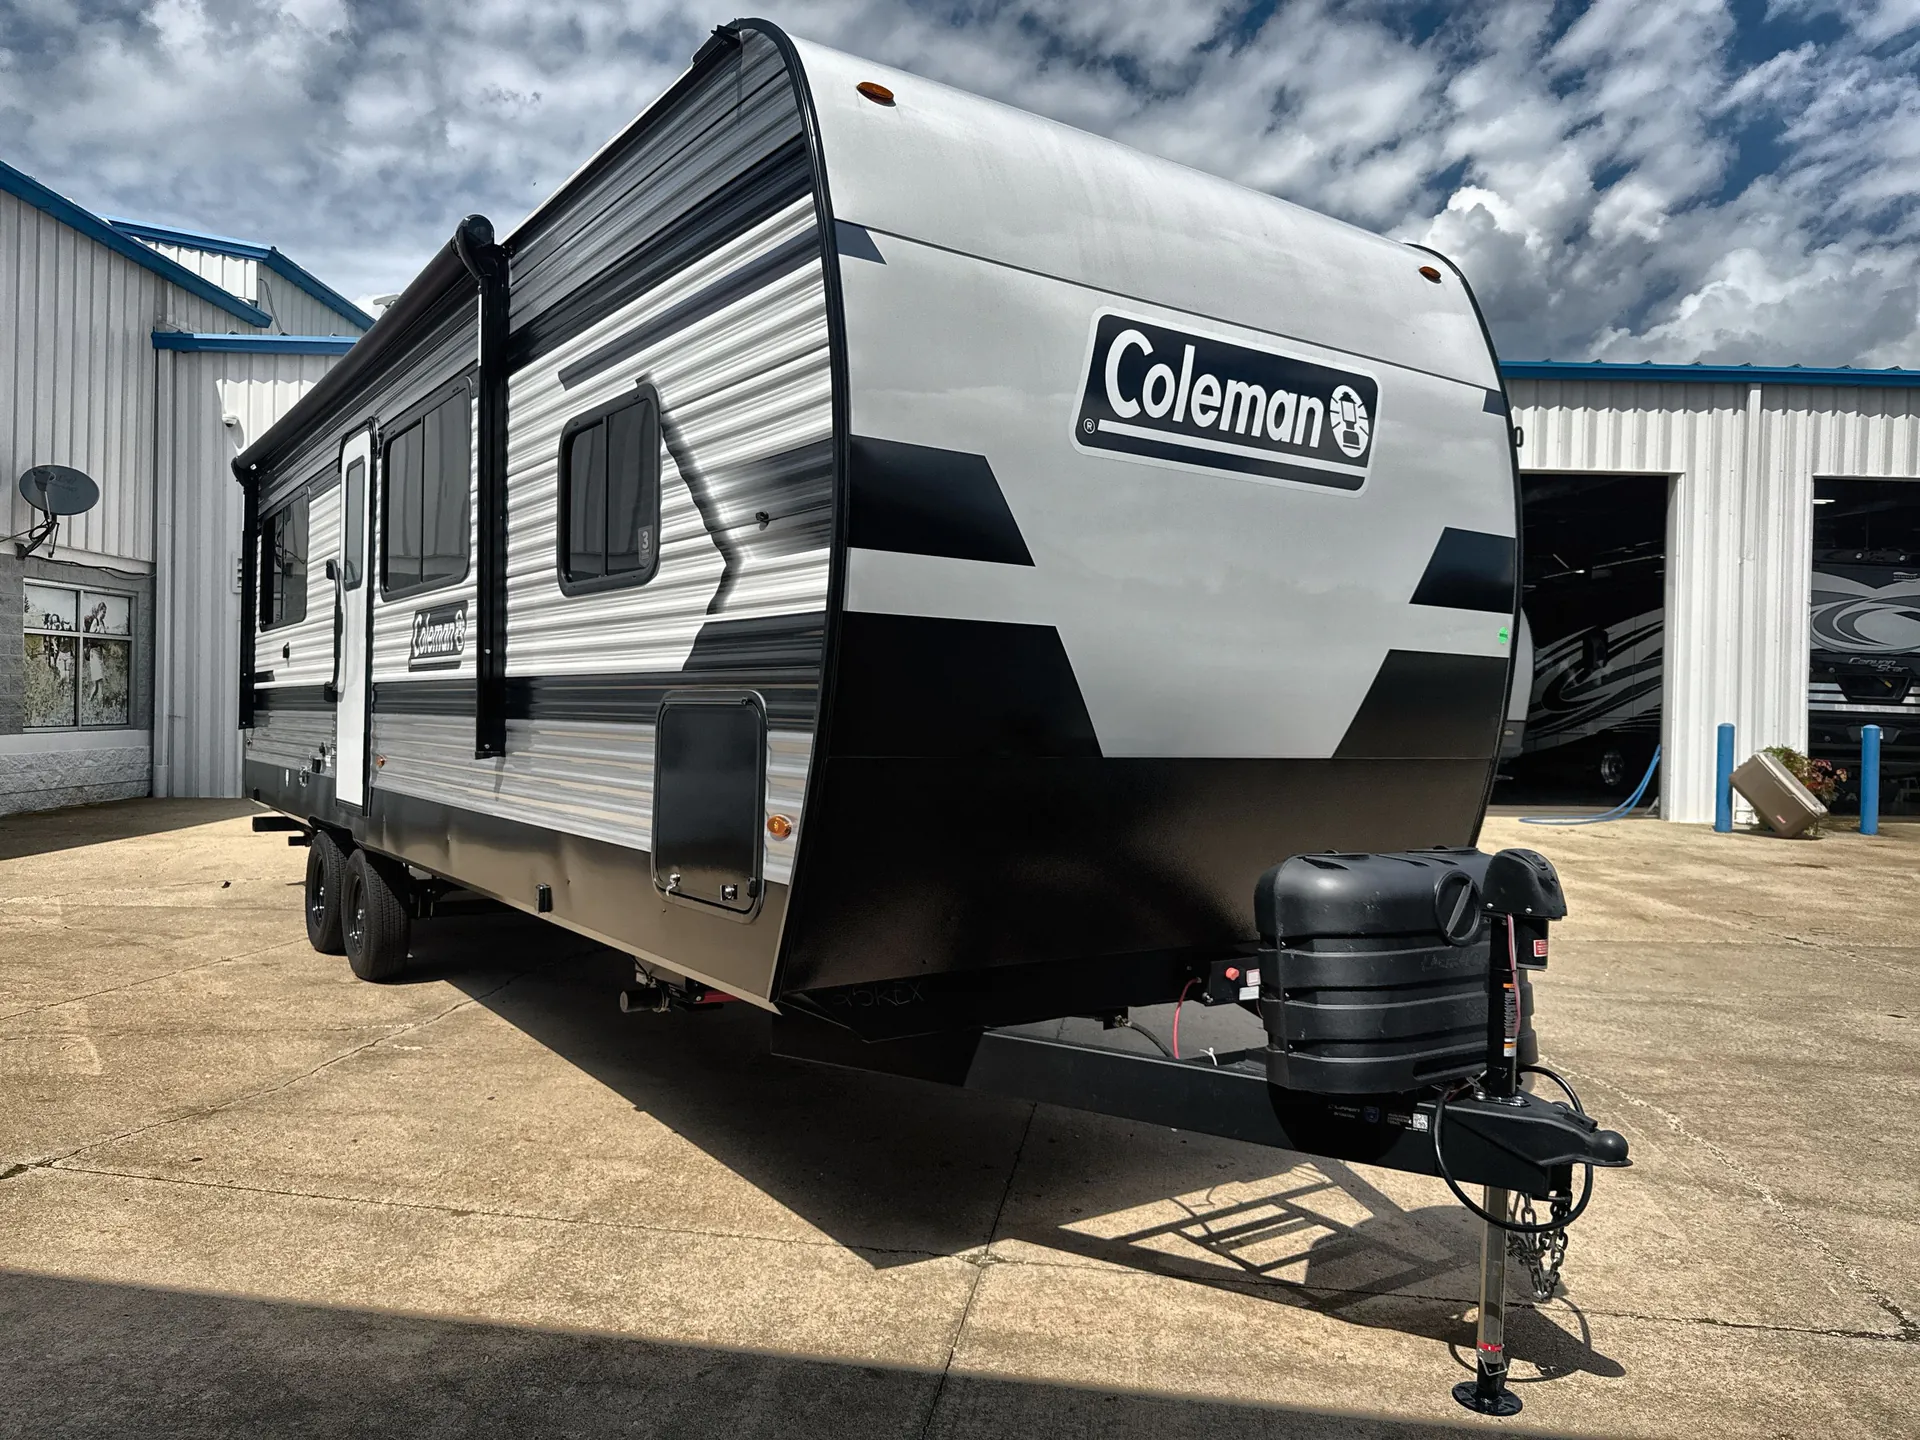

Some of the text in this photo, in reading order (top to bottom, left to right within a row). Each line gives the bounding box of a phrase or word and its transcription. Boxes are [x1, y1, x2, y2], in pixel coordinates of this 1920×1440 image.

[1105, 329, 1325, 449] Coleman
[642, 530, 649, 549] 3
[412, 613, 456, 658] Coleman
[1848, 657, 1897, 667] Canyon
[1875, 664, 1909, 673] Star
